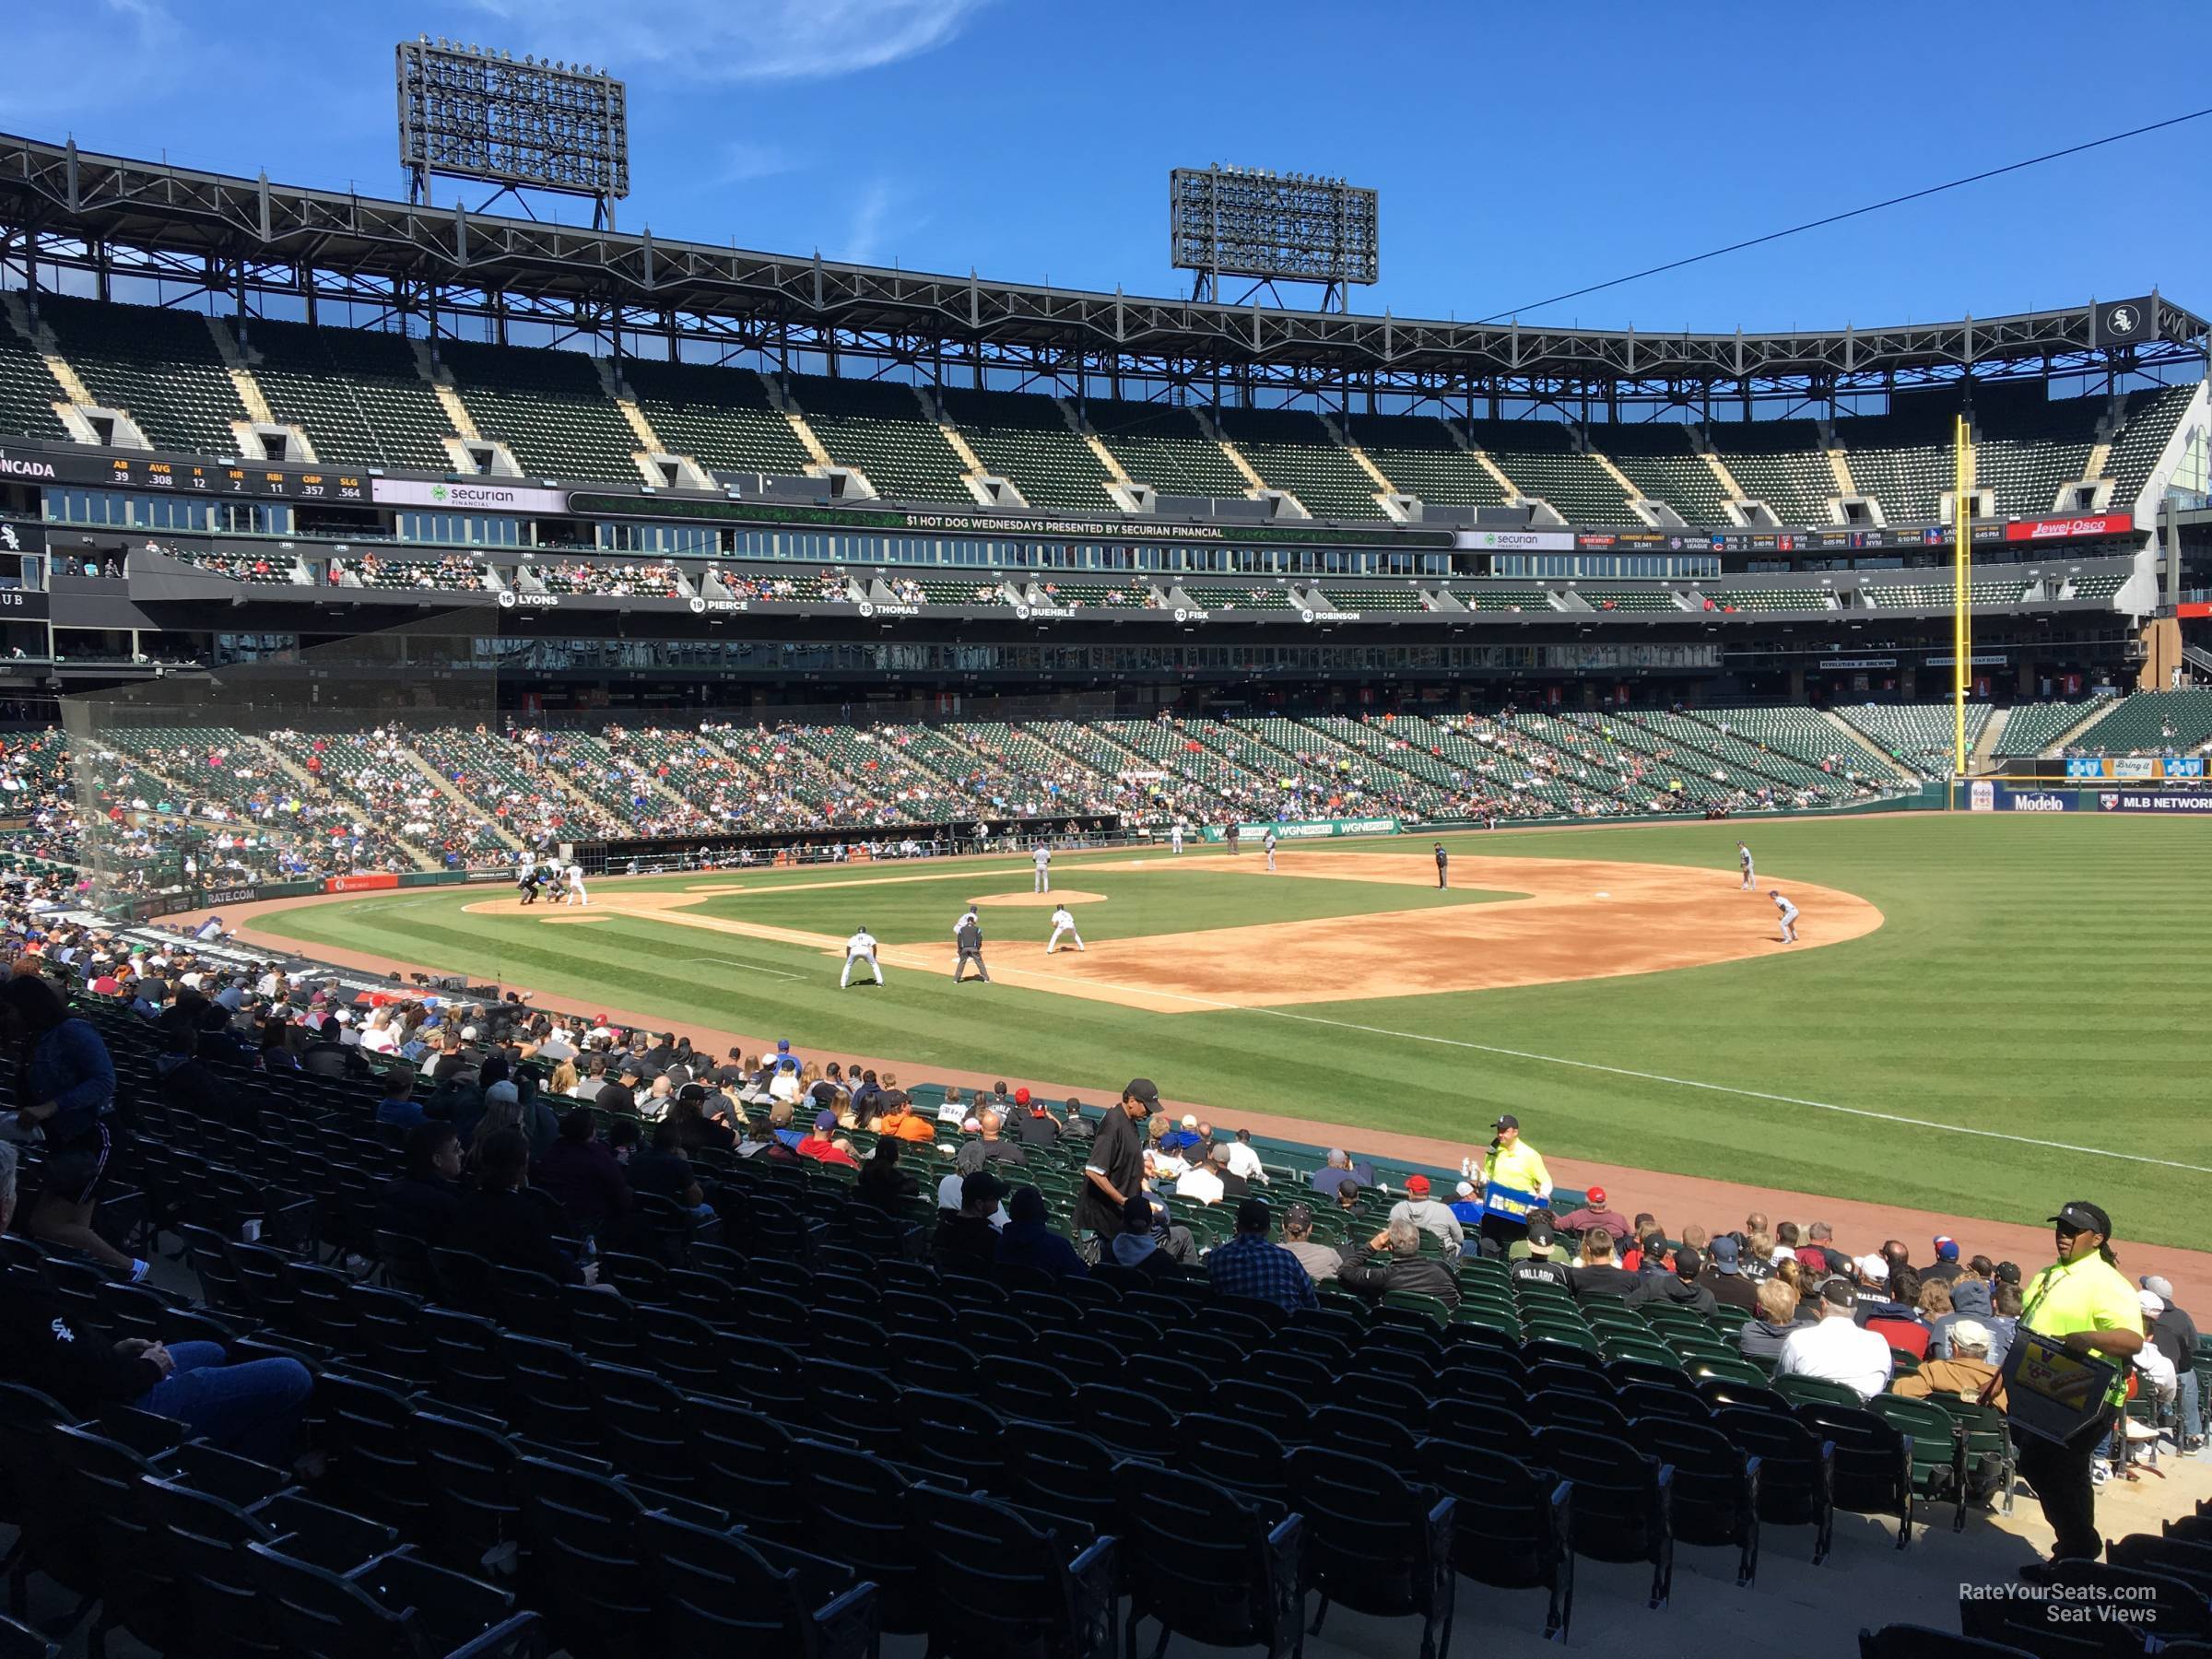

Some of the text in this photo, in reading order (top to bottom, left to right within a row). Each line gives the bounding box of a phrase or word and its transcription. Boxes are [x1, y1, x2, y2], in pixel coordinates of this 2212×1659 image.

[0, 458, 55, 477] NCADA
[113, 460, 128, 469] AB
[148, 464, 171, 473] AVG
[114, 471, 129, 481] 39
[194, 467, 202, 476] H
[229, 470, 243, 479] HR
[148, 474, 172, 485] .308
[266, 473, 283, 482] RBI
[302, 475, 322, 484] OBP
[340, 477, 358, 487] SLG
[193, 478, 206, 488] 12
[234, 481, 241, 490] 2
[271, 483, 283, 493] 11
[301, 486, 324, 496] .357
[338, 488, 360, 498] .564
[451, 488, 514, 502] securian
[921, 516, 942, 527] HOT
[946, 517, 969, 528] DOG
[971, 518, 1043, 531] WEDNESDAYS
[1046, 523, 1103, 534] PRESENTED
[1106, 524, 1120, 534] BY
[1122, 525, 1171, 536] SECURIAN
[1172, 526, 1224, 537] FINANCIAL
[2032, 520, 2106, 534] Jewel-Osco
[1498, 535, 1538, 545] securian
[501, 594, 559, 606] 16 LYONS
[692, 600, 748, 611] 19 PIERCE
[861, 605, 919, 615] 35 THOMAS
[1018, 607, 1076, 618] 56 BUEHRLE
[1188, 611, 1209, 619] FISK
[1303, 612, 1360, 620] 42 ROBINSON
[2116, 759, 2142, 770] Bring
[2015, 794, 2064, 811] Modelo
[2124, 797, 2151, 807] MLB
[1277, 825, 1332, 836] WGN SPORTS
[1341, 822, 1393, 833] WGN SPORTS
[207, 889, 255, 904] RATE.COM
